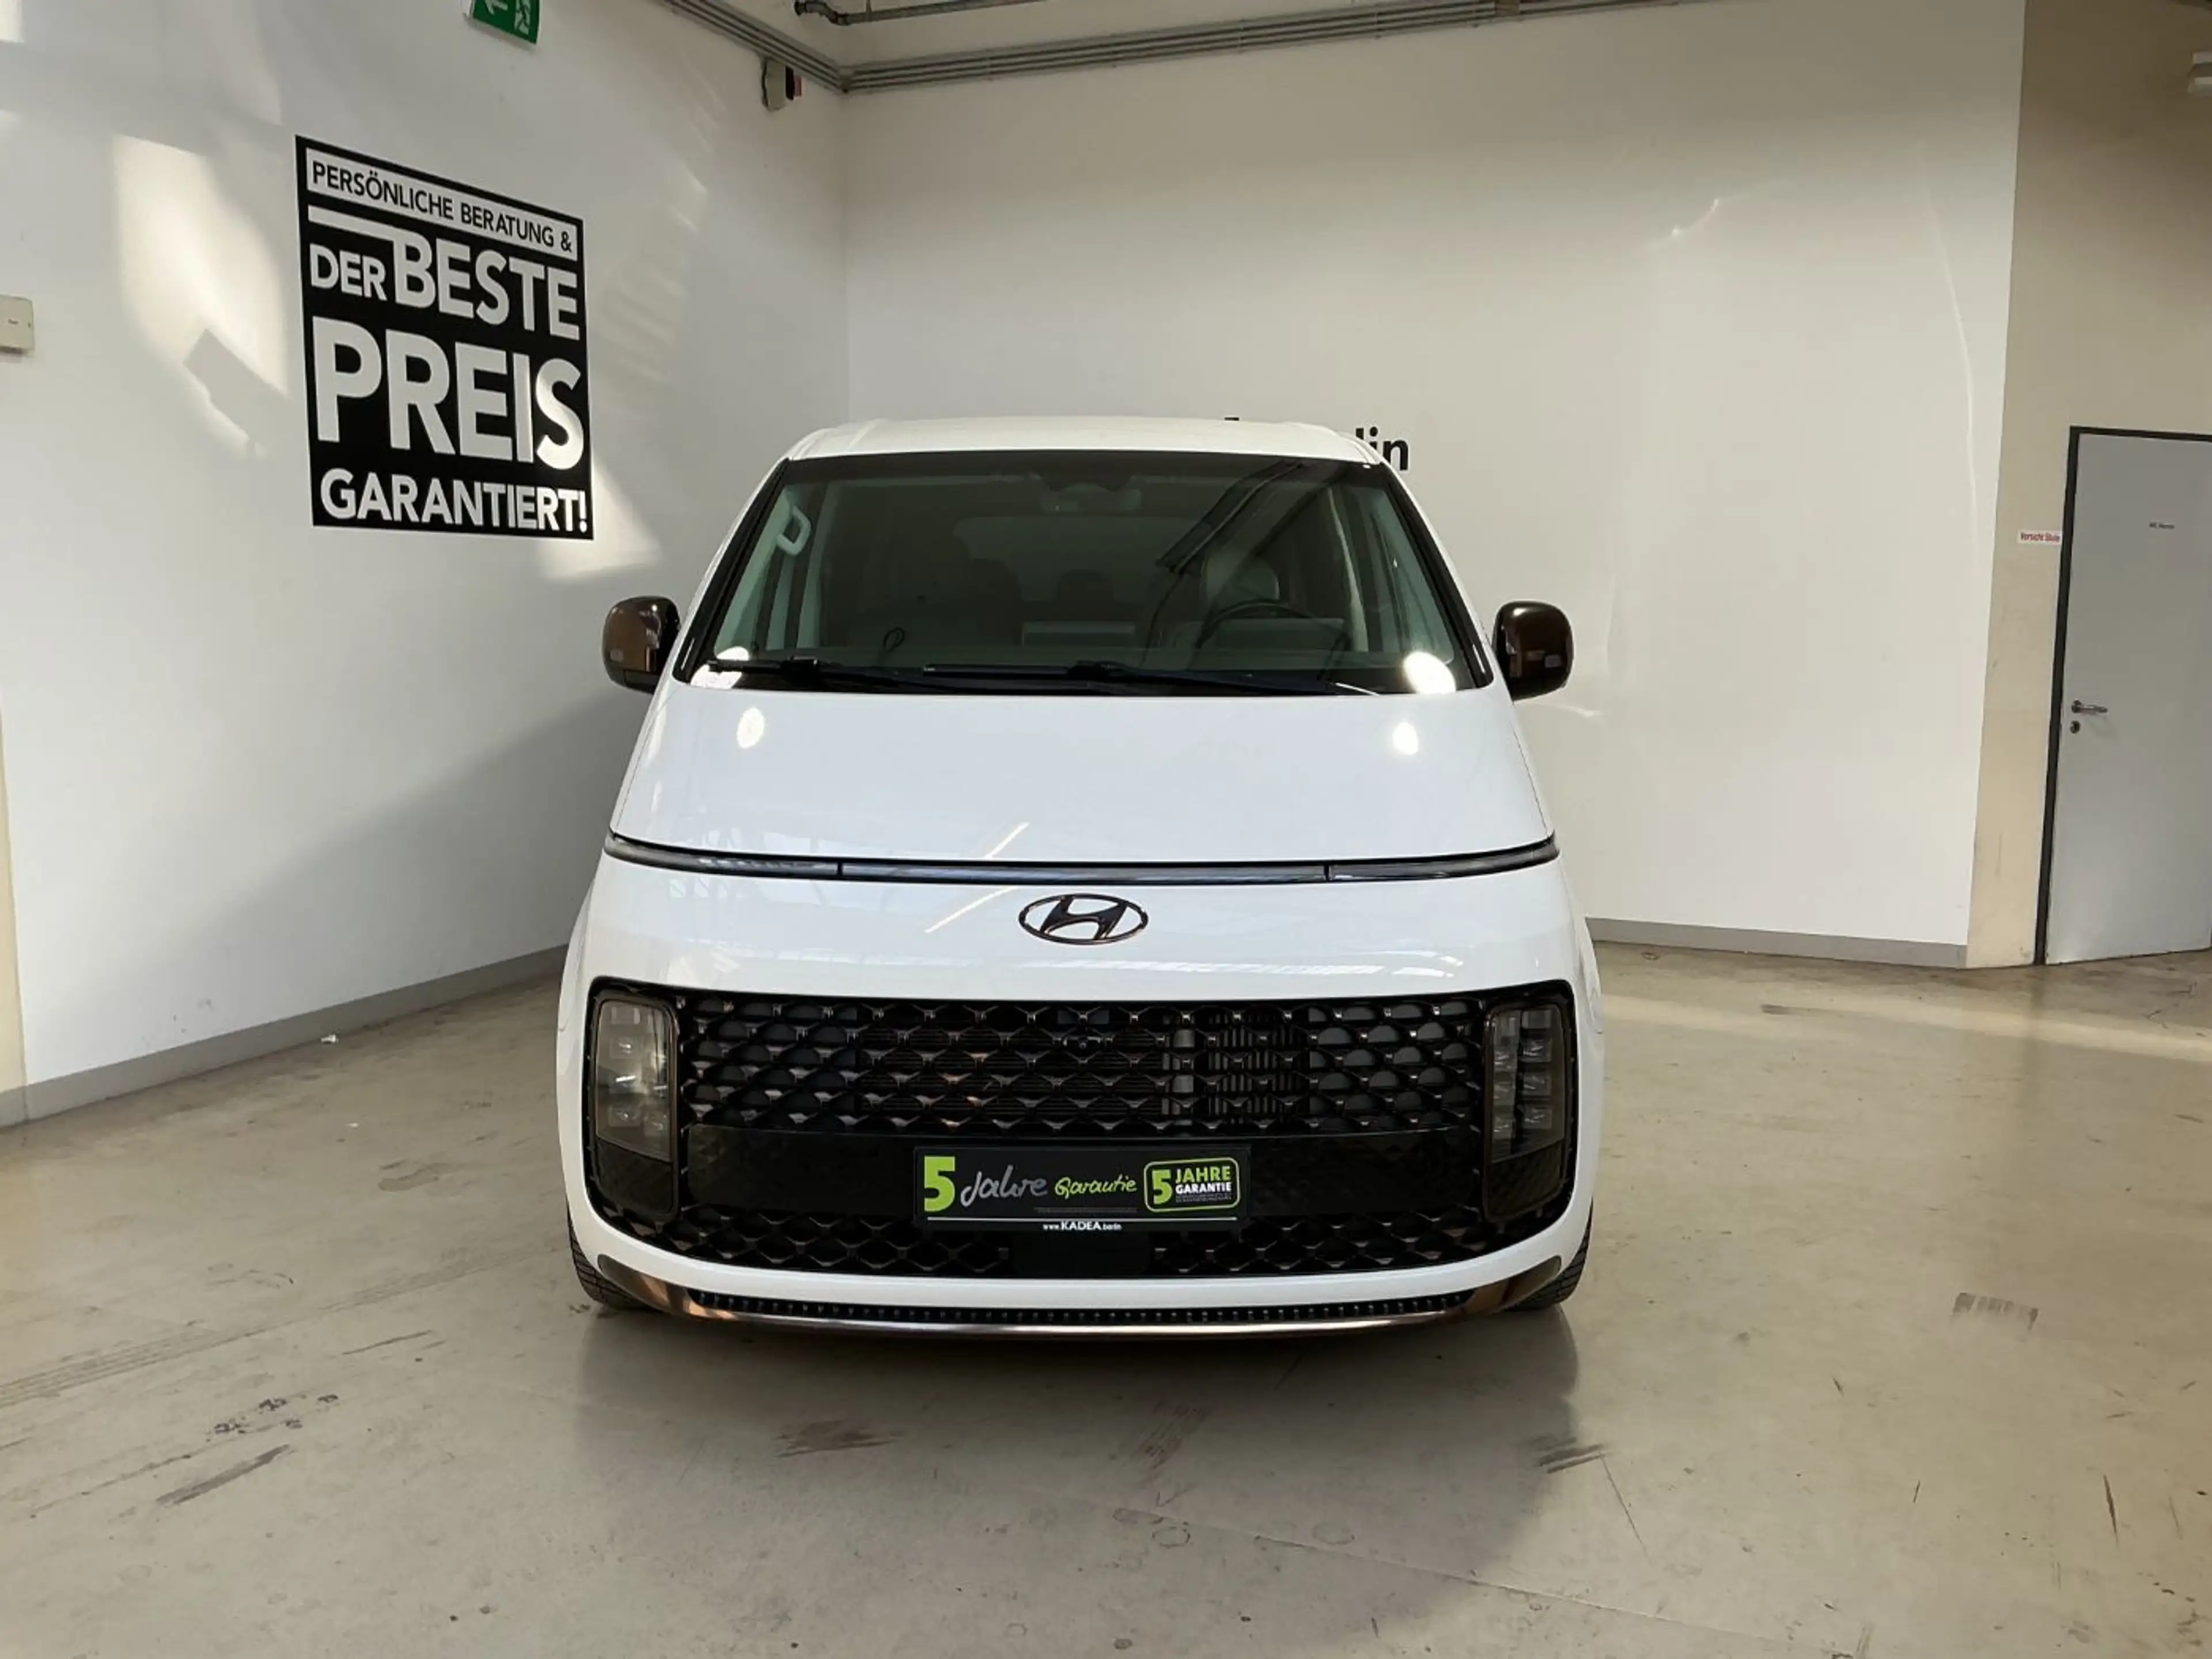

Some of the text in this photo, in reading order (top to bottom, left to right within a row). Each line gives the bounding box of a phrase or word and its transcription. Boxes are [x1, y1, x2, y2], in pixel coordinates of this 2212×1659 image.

[313, 160, 573, 252] PERSÖNLICHE BERATUNG &
[309, 228, 581, 341] DER BESTE
[312, 315, 584, 470] PREIS
[320, 467, 588, 533] GARANTIERT!
[924, 1156, 956, 1212] 5
[1153, 1165, 1232, 1205] 5 JAHRE
[1175, 1181, 1232, 1194] GARANTIE
